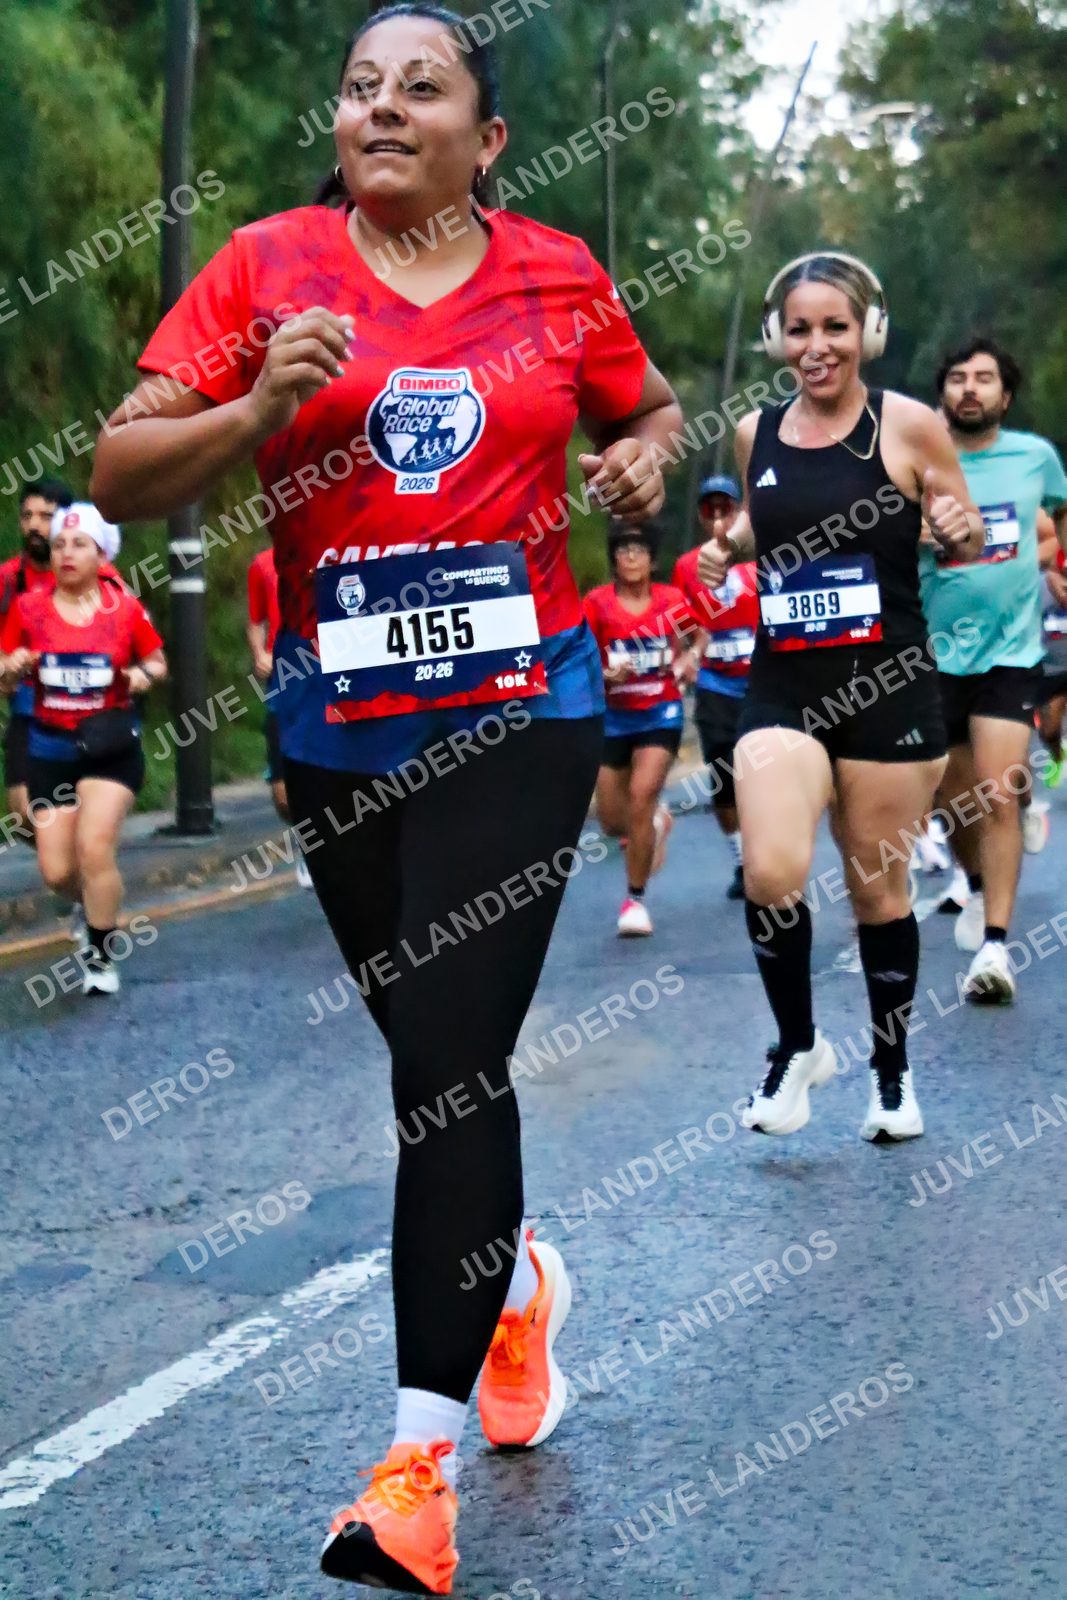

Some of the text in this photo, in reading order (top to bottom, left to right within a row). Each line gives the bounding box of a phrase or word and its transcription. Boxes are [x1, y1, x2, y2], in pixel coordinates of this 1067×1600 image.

[399, 378, 460, 391] BIMBO
[397, 396, 459, 417] Global
[383, 414, 433, 433] Race
[399, 477, 435, 490] 2026
[788, 592, 841, 619] 3869
[386, 606, 475, 659] 4155
[415, 662, 454, 681] 20-26
[495, 673, 527, 689] 10K
